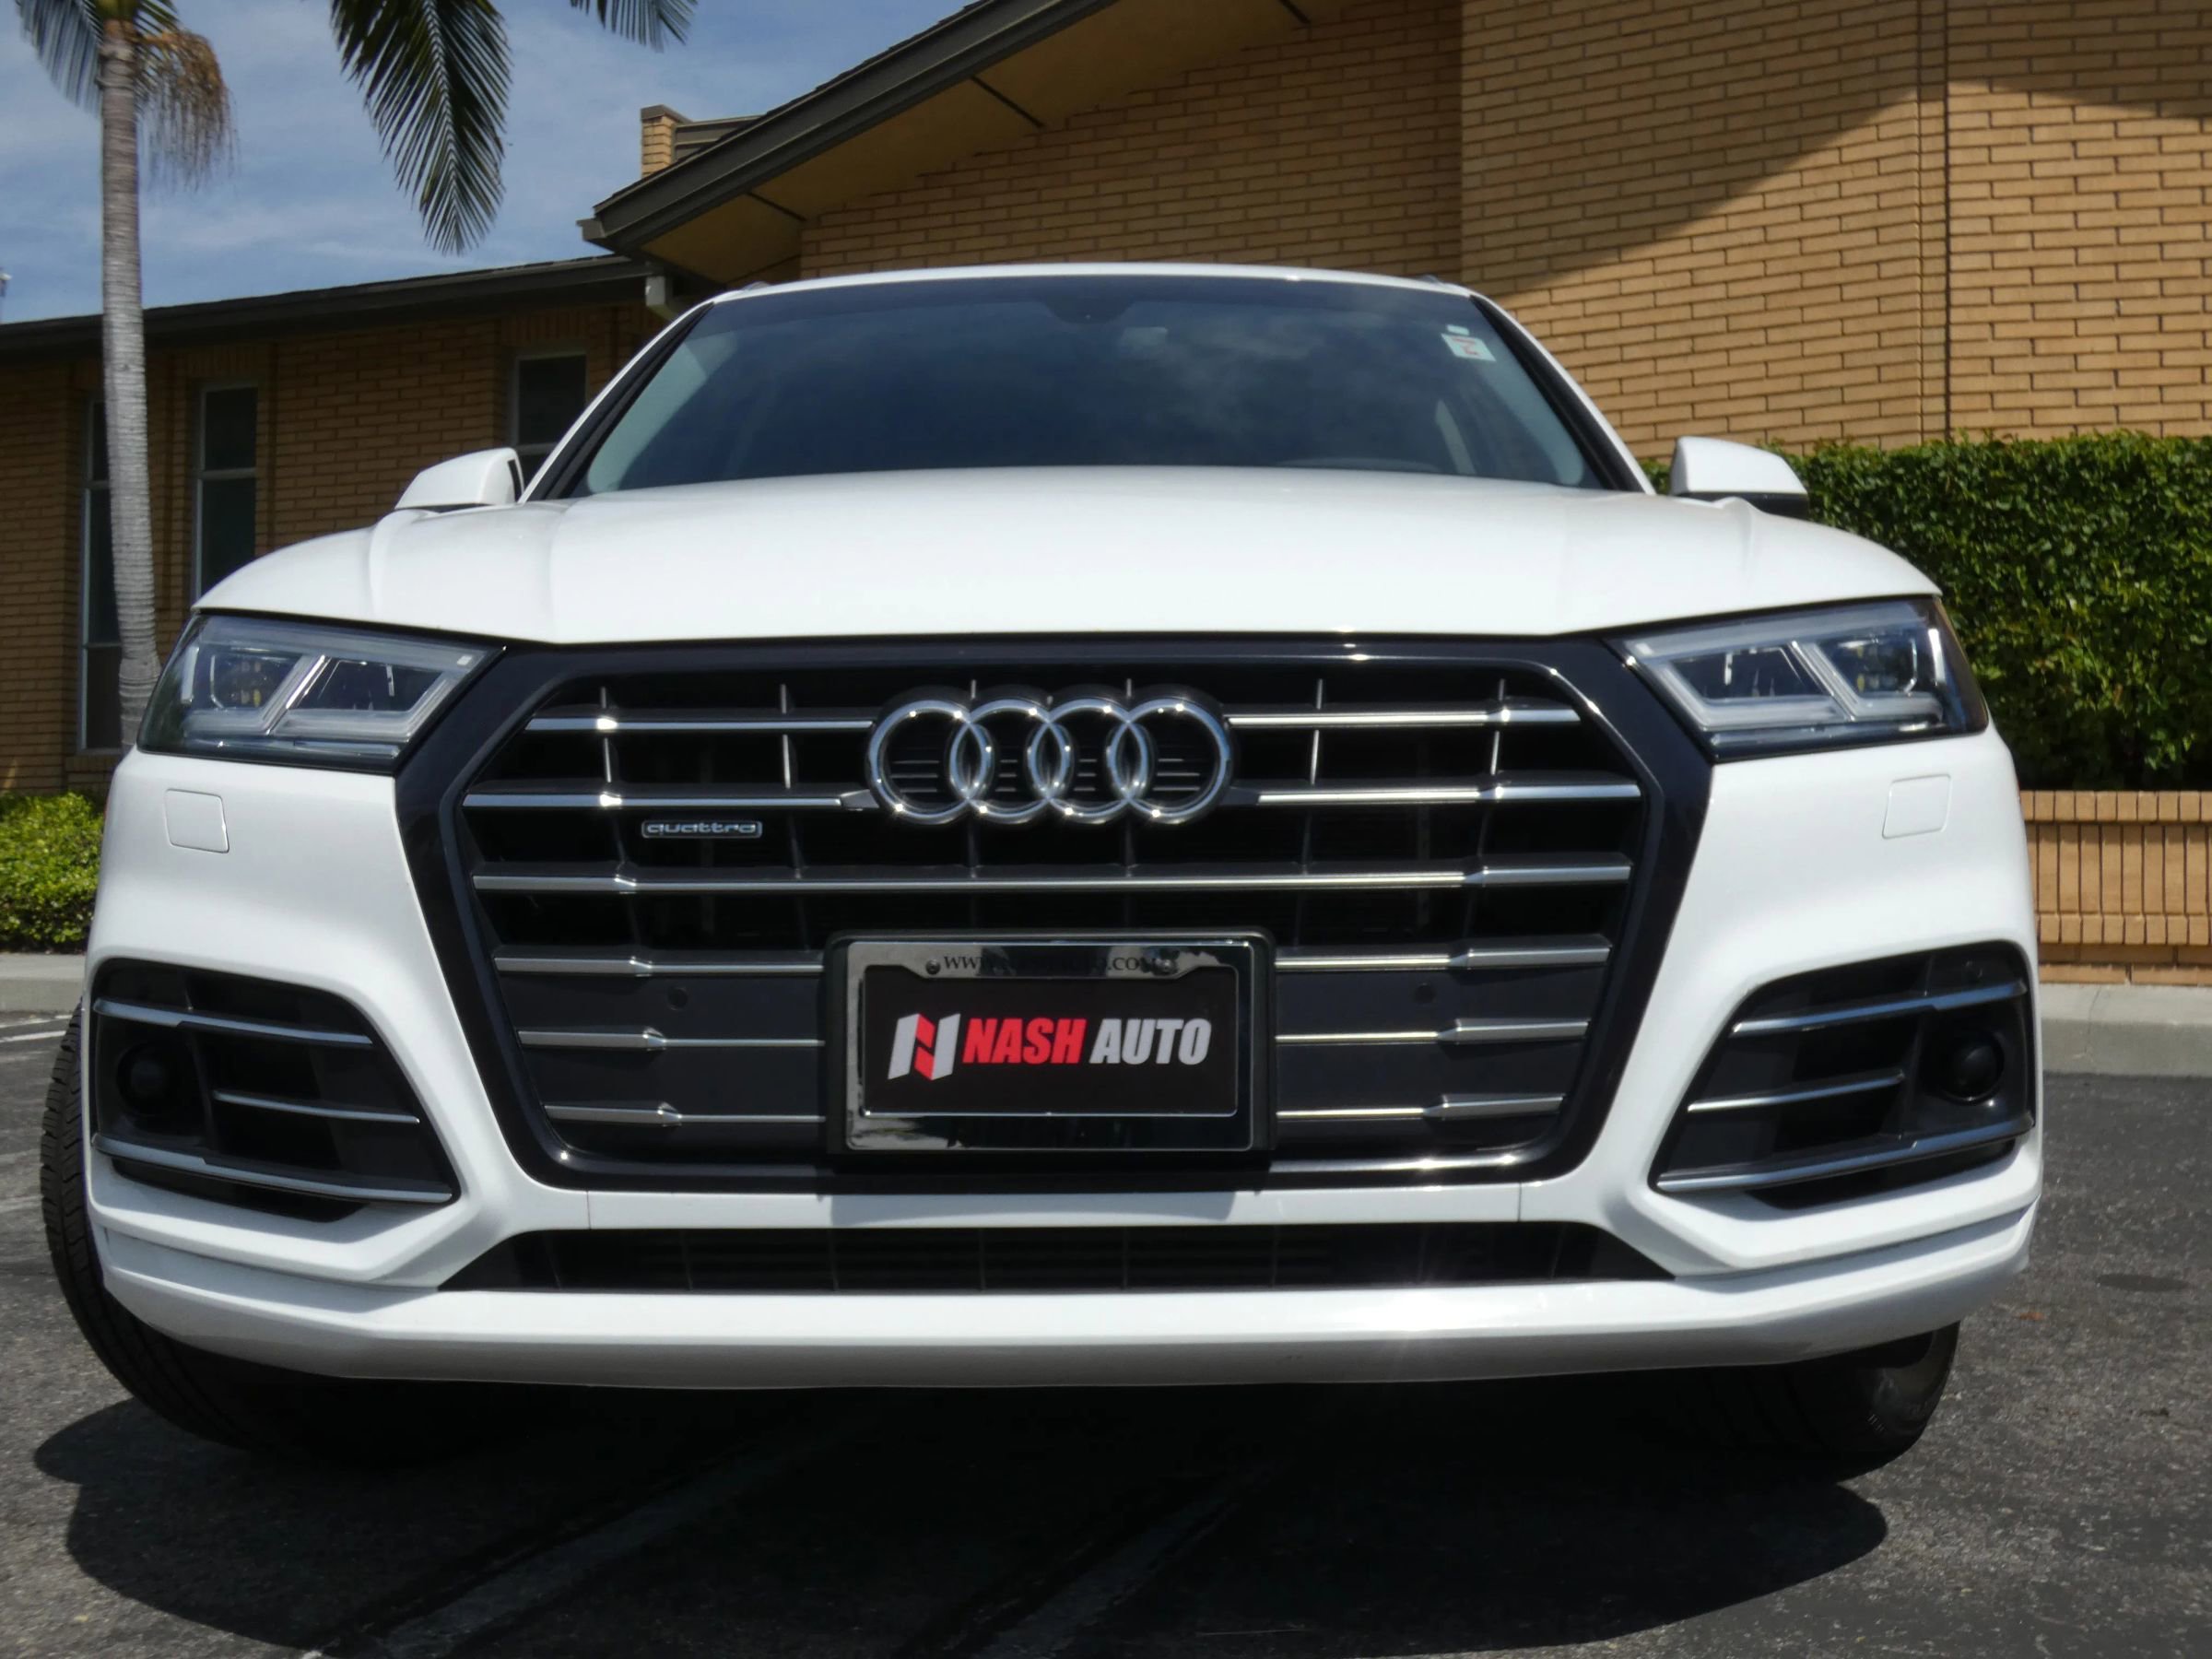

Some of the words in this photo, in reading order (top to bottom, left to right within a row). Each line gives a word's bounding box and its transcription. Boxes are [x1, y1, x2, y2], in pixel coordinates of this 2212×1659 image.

[647, 822, 756, 835] quattro
[962, 1018, 1088, 1065] NASH
[1089, 1018, 1213, 1065] AUTO
